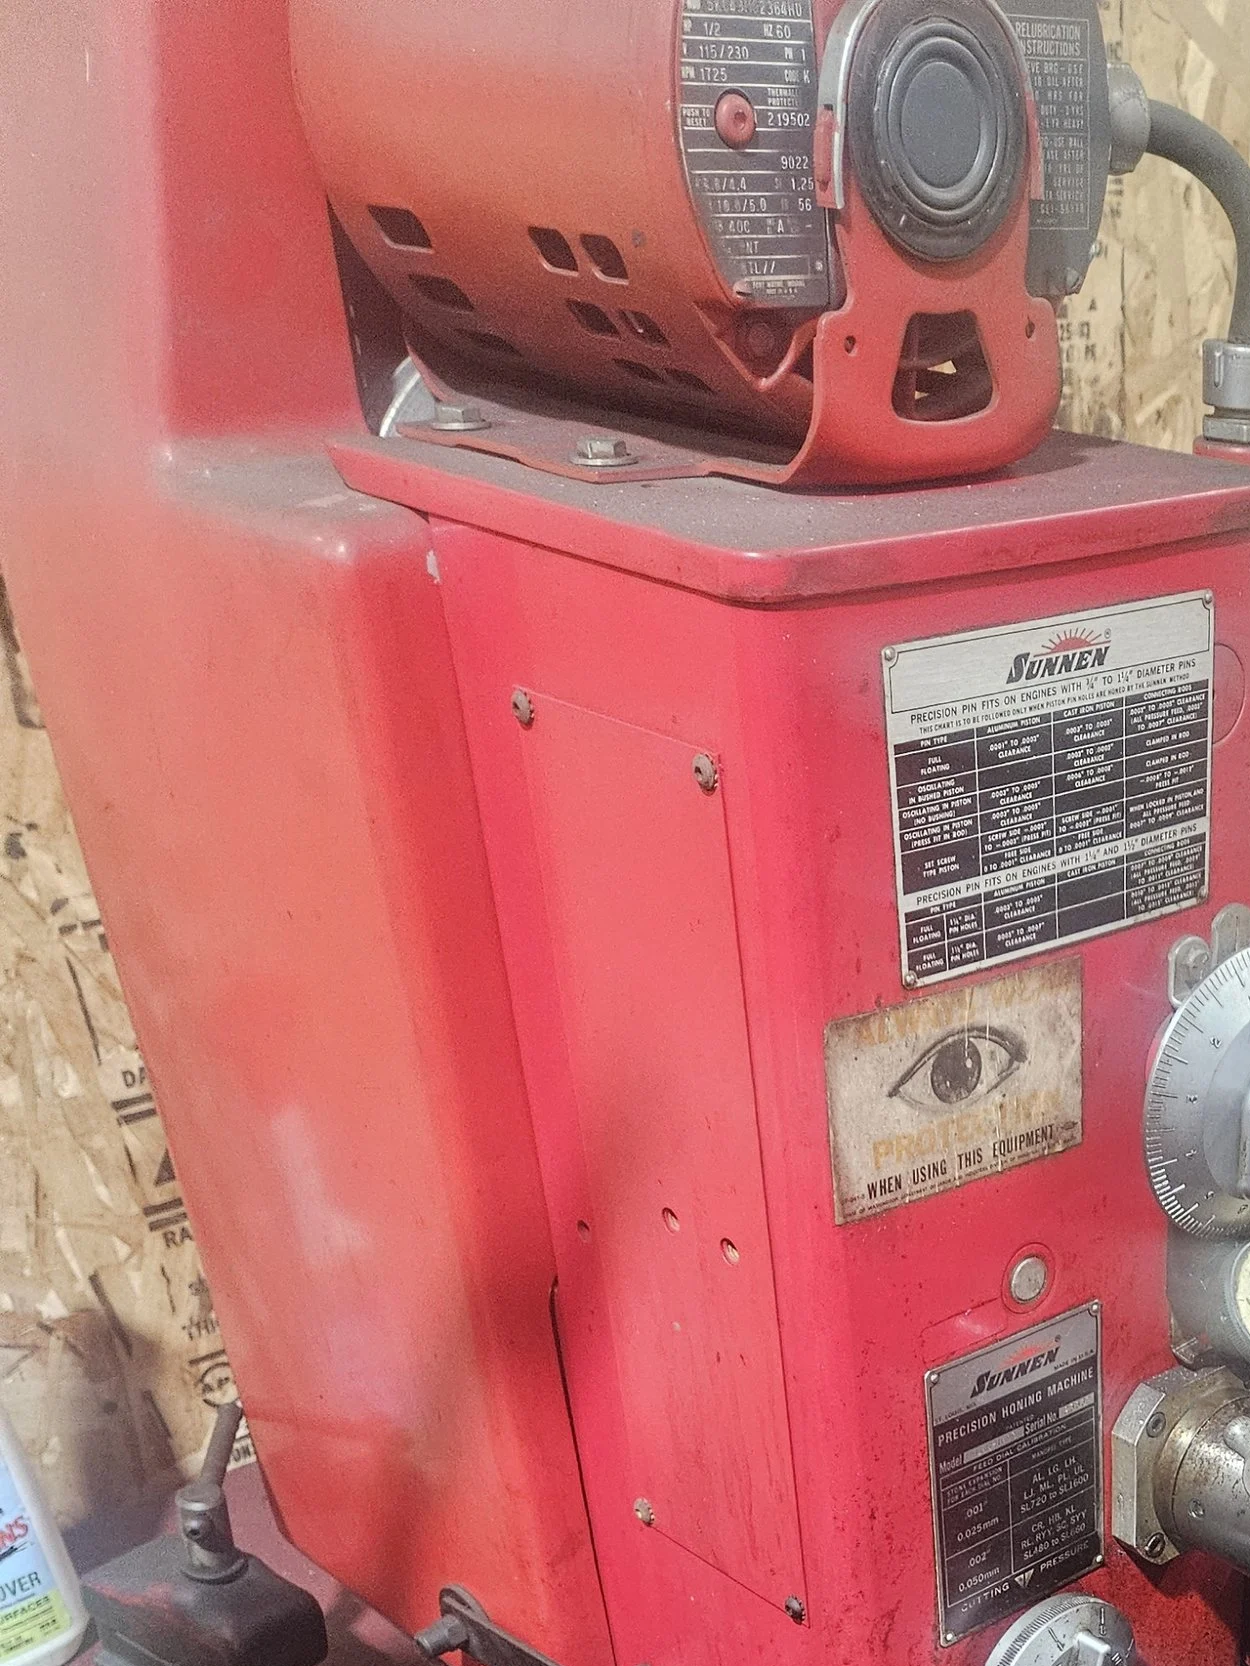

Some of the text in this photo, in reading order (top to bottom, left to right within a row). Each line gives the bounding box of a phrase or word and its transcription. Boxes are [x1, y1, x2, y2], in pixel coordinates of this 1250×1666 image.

[703, 22, 721, 36] 1/2
[776, 25, 791, 39] 60
[1015, 22, 1081, 40] RELUBRICATION
[1020, 40, 1081, 56] NSTRUCTIONS
[700, 68, 728, 82] 1725
[803, 70, 811, 83] K
[781, 156, 809, 169] 9022
[791, 178, 814, 190] 1.25
[799, 198, 812, 211] 56
[1006, 645, 1111, 684] SUNNEN
[910, 705, 956, 724] PRECISION
[961, 701, 976, 714] PIN
[981, 697, 999, 710] FITS
[1004, 694, 1016, 705] ON
[1021, 686, 1056, 702] ENGINES
[1061, 680, 1081, 694] WITH
[1102, 674, 1112, 685] TO
[1136, 662, 1174, 678] DIAMETER
[1178, 657, 1195, 670] PINS
[1143, 687, 1176, 700] CONNECTING
[919, 724, 933, 734] THIS
[934, 720, 954, 731] CHART
[955, 718, 961, 726] IS
[963, 716, 971, 725] TO
[972, 715, 979, 723] BE
[981, 708, 1010, 721] FOLLOWED
[1011, 705, 1027, 715] ONLY
[1028, 702, 1044, 712] WHEN
[1045, 697, 1064, 708] PISTON
[1066, 695, 1076, 704] PIN
[1078, 691, 1094, 702] HOLES
[1095, 689, 1105, 698] ARE
[1108, 685, 1125, 695] HONED
[1063, 700, 1114, 717] CAST IRON PISTON
[986, 716, 1040, 734] ALUMINUM PISTON
[920, 735, 947, 748] PIN TYPE
[1010, 738, 1018, 747] TO
[1073, 728, 1104, 742] CLEARANCE
[1145, 735, 1168, 746] CLAMPED
[997, 744, 1031, 758] CLEARANCE
[927, 755, 941, 764] FULL
[1145, 755, 1168, 767] CLAMPED
[920, 762, 949, 776] FLOATING
[917, 778, 954, 793] OSCILLATING
[908, 785, 964, 805] IN BUSHED PISTON
[999, 791, 1032, 805] CLEARANCE
[902, 796, 971, 819] OSCILLATING IN PISTON
[999, 812, 1032, 826] CLEARANCE
[903, 818, 972, 841] OSCILLATING IN PISTON
[943, 832, 950, 841] IN
[987, 827, 1020, 842] SCREW SIDE
[916, 885, 961, 905] PRECISION
[965, 880, 980, 892] PIN
[984, 874, 1001, 887] FITS
[1005, 870, 1017, 882] ON
[1022, 860, 1056, 877] ENGINES
[1060, 854, 1080, 867] WITH
[1103, 844, 1118, 856] AND
[1140, 828, 1177, 846] DIAMETER
[1180, 823, 1196, 834] PINS
[924, 854, 956, 869] SET SCREW
[989, 863, 997, 871] TO
[1019, 849, 1051, 863] CLEARANCE
[938, 862, 959, 874] PISTON
[920, 923, 933, 933] FULL
[912, 930, 941, 944] FLOATING
[1210, 1037, 1222, 1049] 2
[867, 1122, 1054, 1201] WHEN USING THIS EQUIPMENT
[970, 1346, 1060, 1398] SUNNEN
[937, 1410, 996, 1448] PRECISION
[1001, 1389, 1041, 1419] HONING
[1046, 1365, 1093, 1397] MACHINE
[1025, 1413, 1046, 1435] Serial
[973, 1456, 993, 1472] FEED
[996, 1446, 1013, 1462] DIAL
[1016, 1422, 1066, 1452] CALIBRATION
[939, 1453, 962, 1475] Model
[1020, 1492, 1046, 1514] SL720
[1049, 1488, 1056, 1500] to
[957, 1514, 999, 1543] 0.025mm
[958, 1564, 999, 1593] 0.050mm
[960, 1539, 1088, 1613] CUTTING PRESSURE
